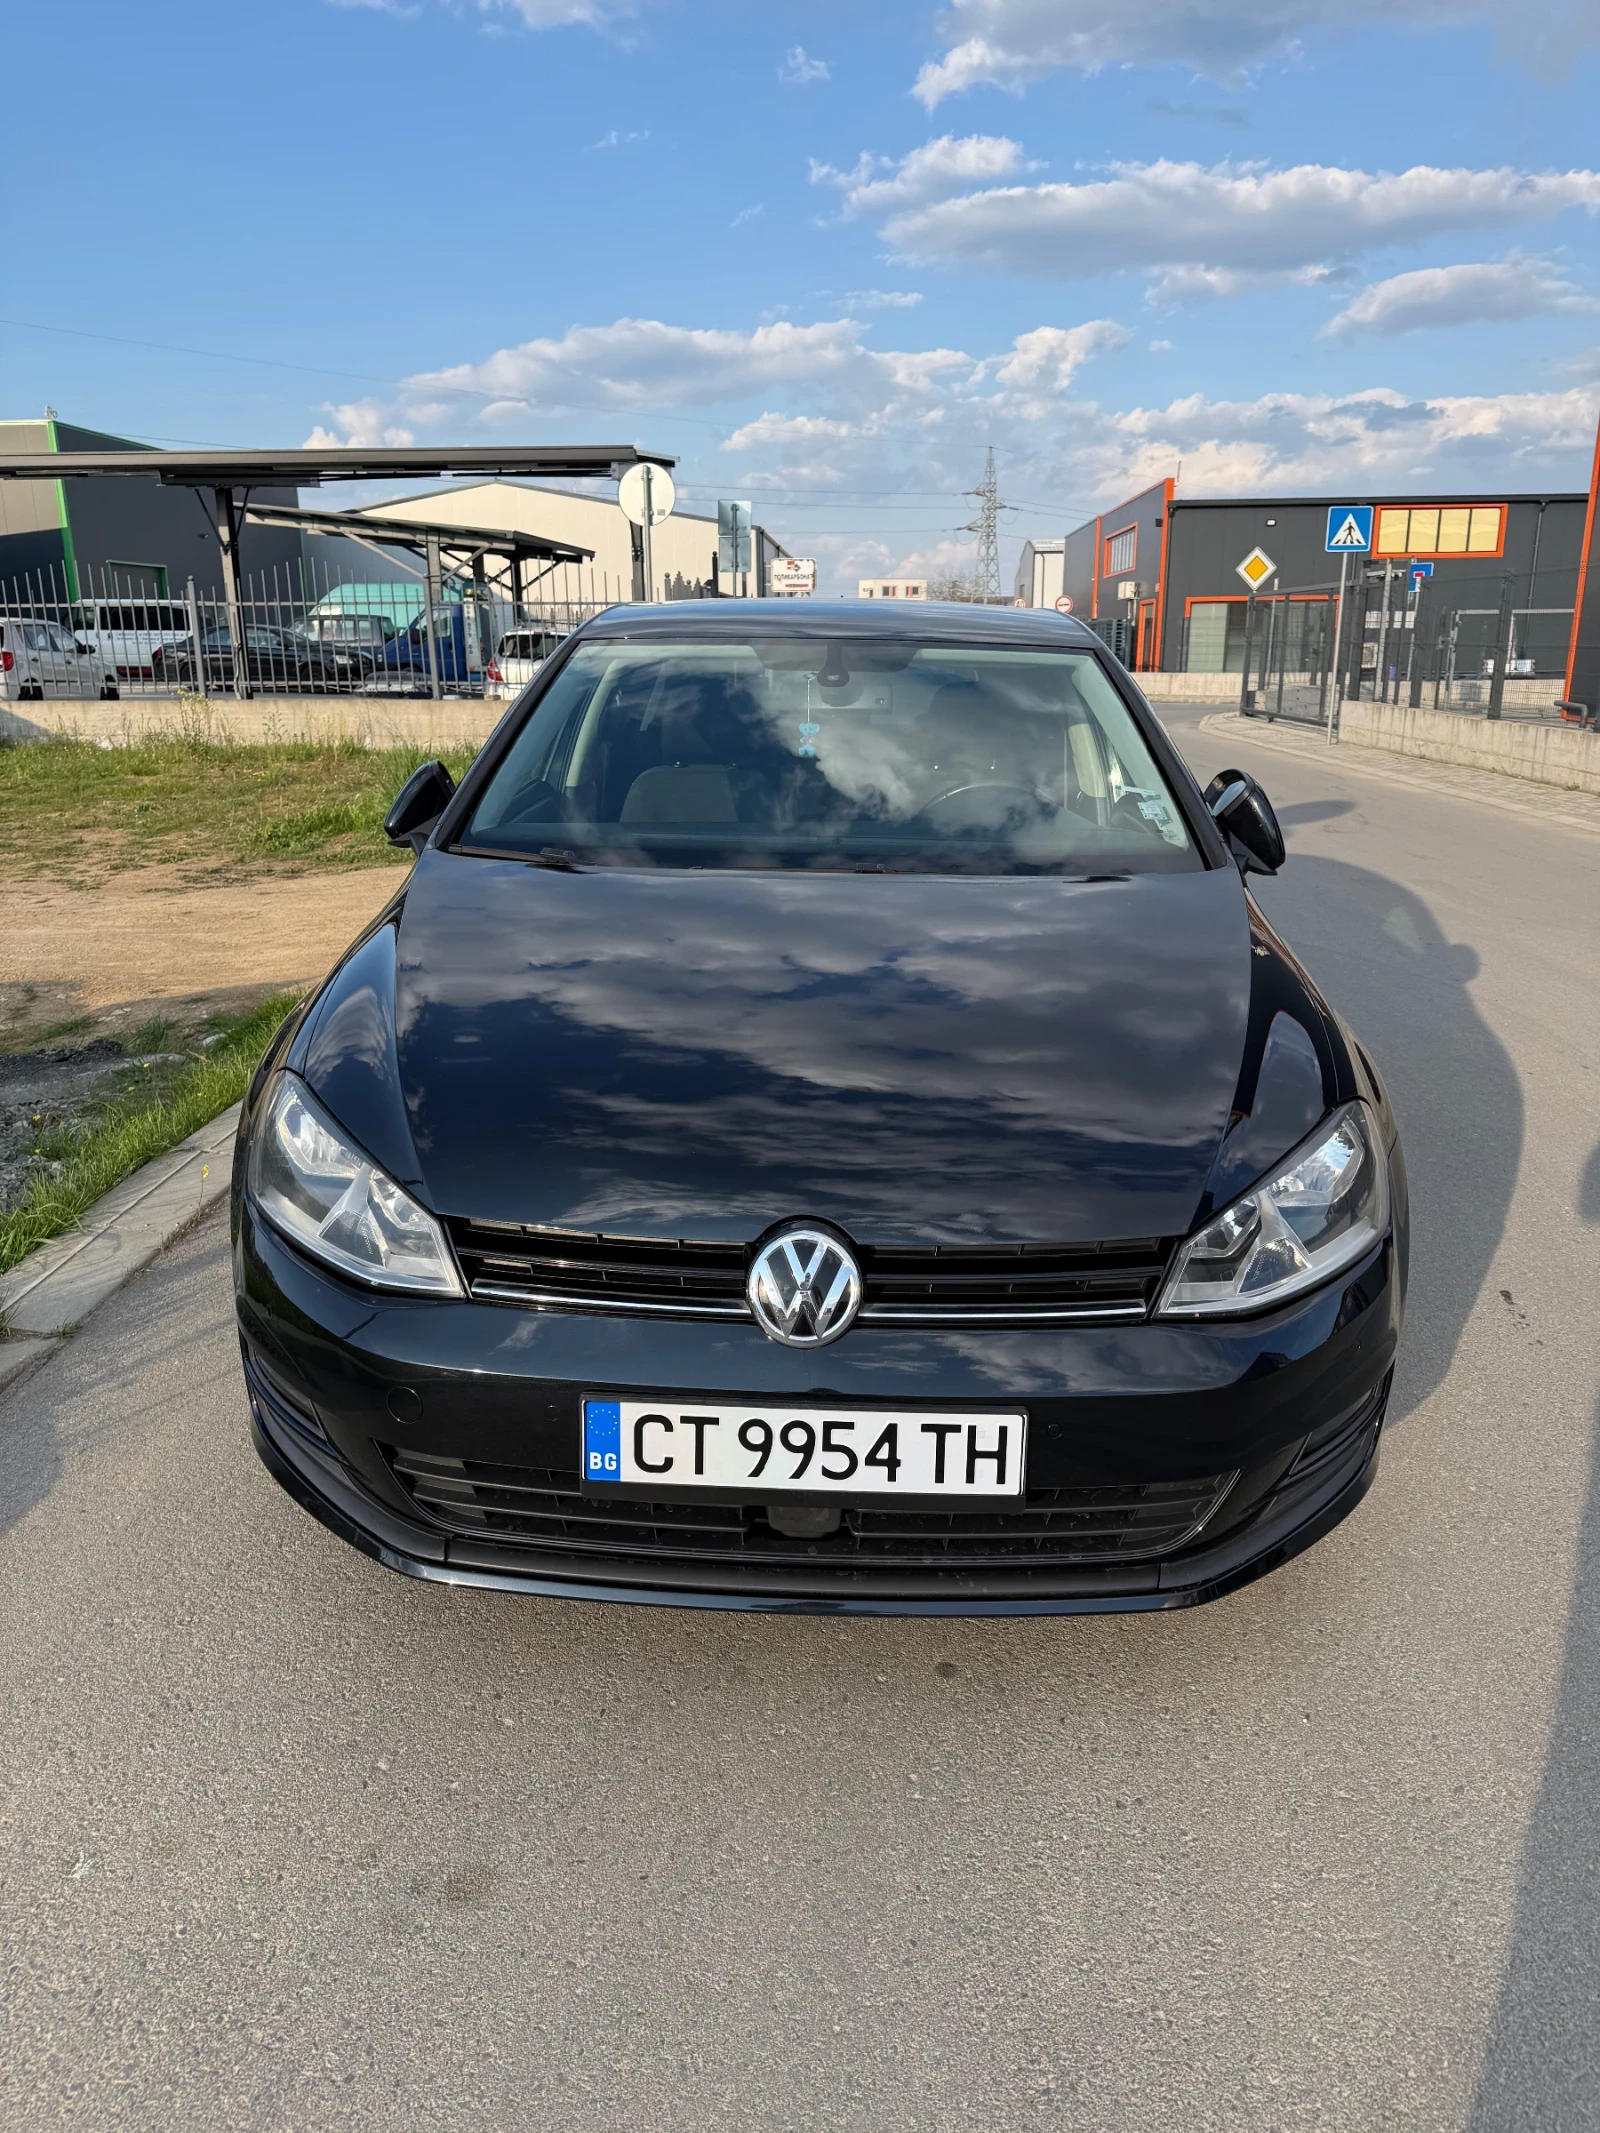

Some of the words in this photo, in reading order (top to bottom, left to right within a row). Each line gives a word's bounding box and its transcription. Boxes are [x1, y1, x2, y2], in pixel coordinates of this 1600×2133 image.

[589, 1452, 617, 1471] BG
[633, 1413, 720, 1475] CT
[737, 1418, 902, 1482] 9954
[920, 1423, 1008, 1485] TH
